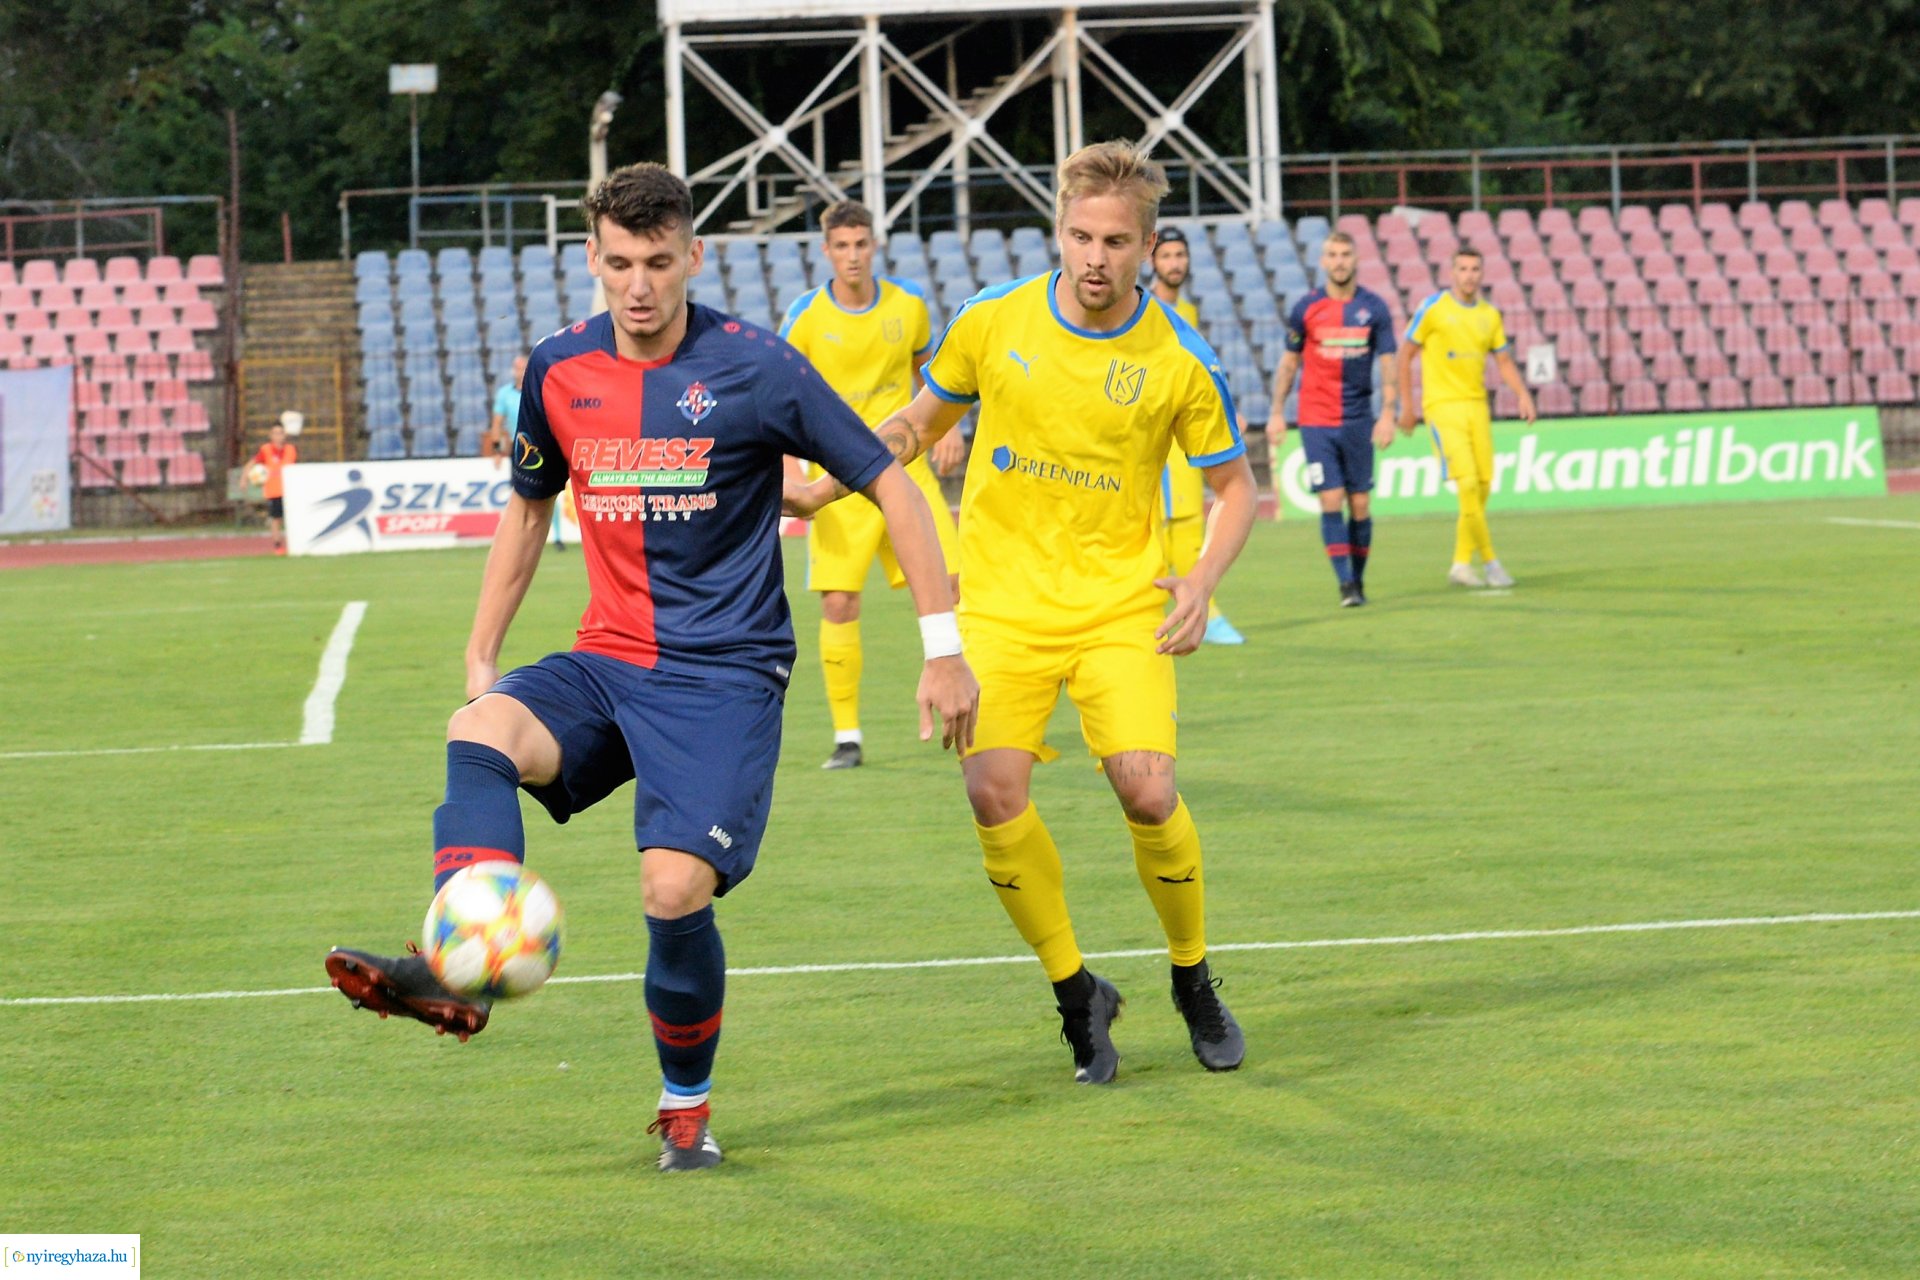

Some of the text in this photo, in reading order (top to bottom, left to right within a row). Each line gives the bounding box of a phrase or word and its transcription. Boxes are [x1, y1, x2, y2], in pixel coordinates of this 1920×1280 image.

[570, 397, 602, 409] JAKO
[571, 437, 715, 471] REVESZ
[1376, 422, 1876, 498] mrkantilbank
[592, 473, 704, 483] ALWAYS ON THE RIGHT WAY
[1017, 457, 1121, 492] GREENPLAN
[647, 491, 718, 512] TRANS
[385, 515, 453, 532] SPORT
[708, 824, 733, 849] JAKO
